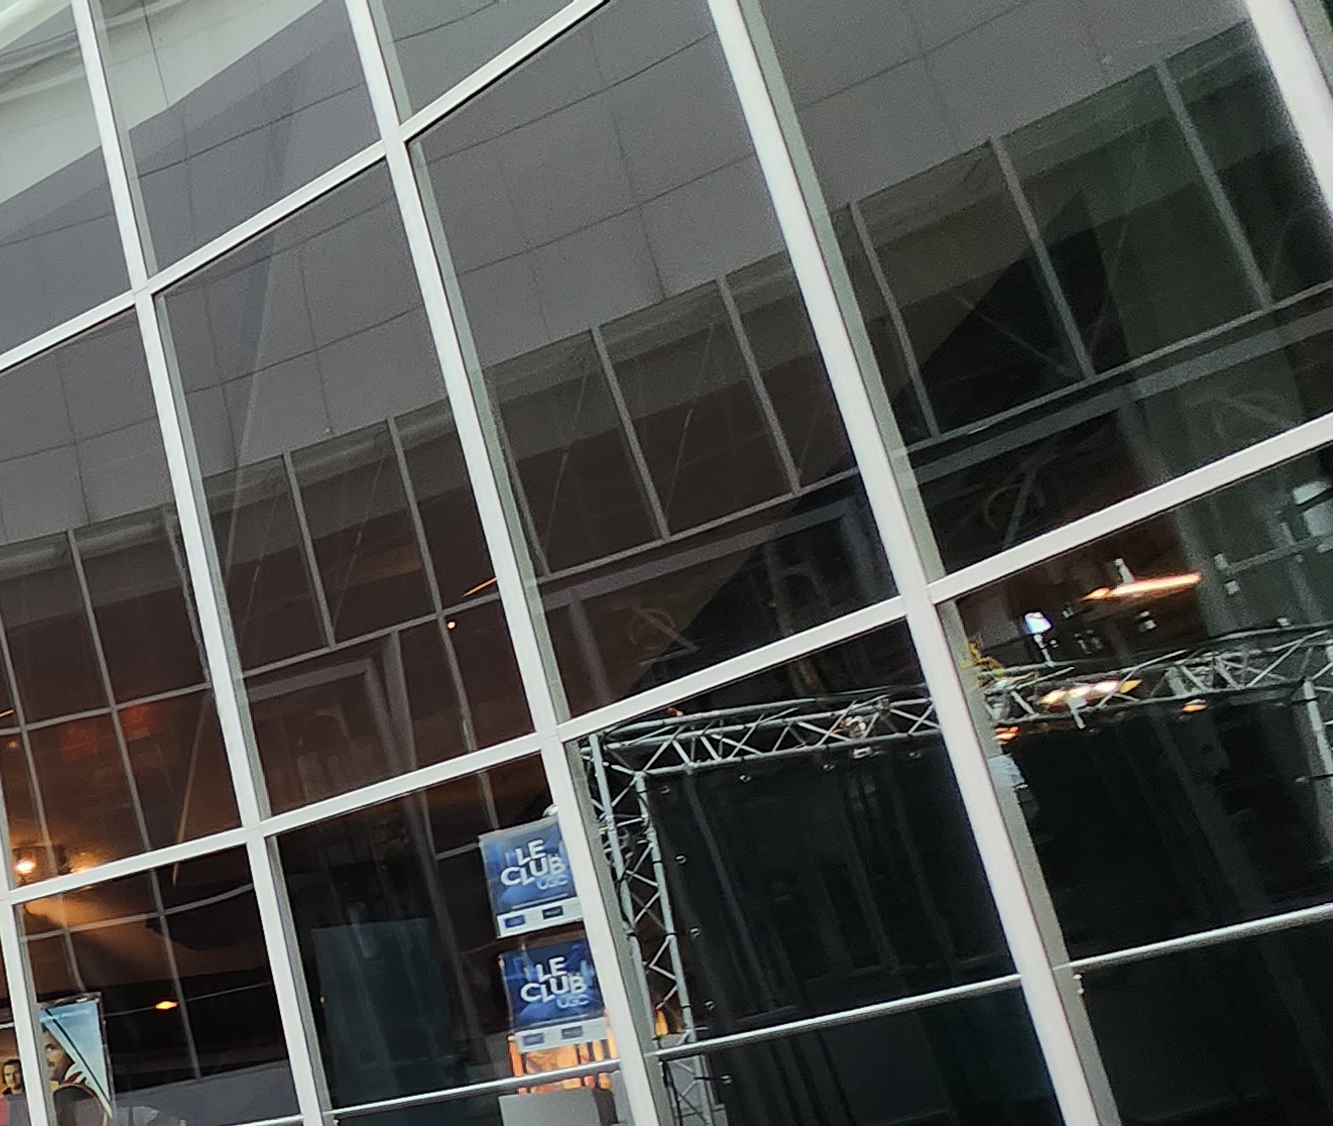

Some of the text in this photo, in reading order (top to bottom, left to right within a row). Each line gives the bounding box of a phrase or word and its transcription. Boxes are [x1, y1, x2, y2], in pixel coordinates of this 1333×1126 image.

[515, 839, 547, 866] LE
[501, 855, 566, 886] CLUB
[536, 875, 570, 890] UGC
[535, 956, 568, 982] LE
[520, 975, 588, 1003] CLUB
[556, 994, 590, 1009] UGC
